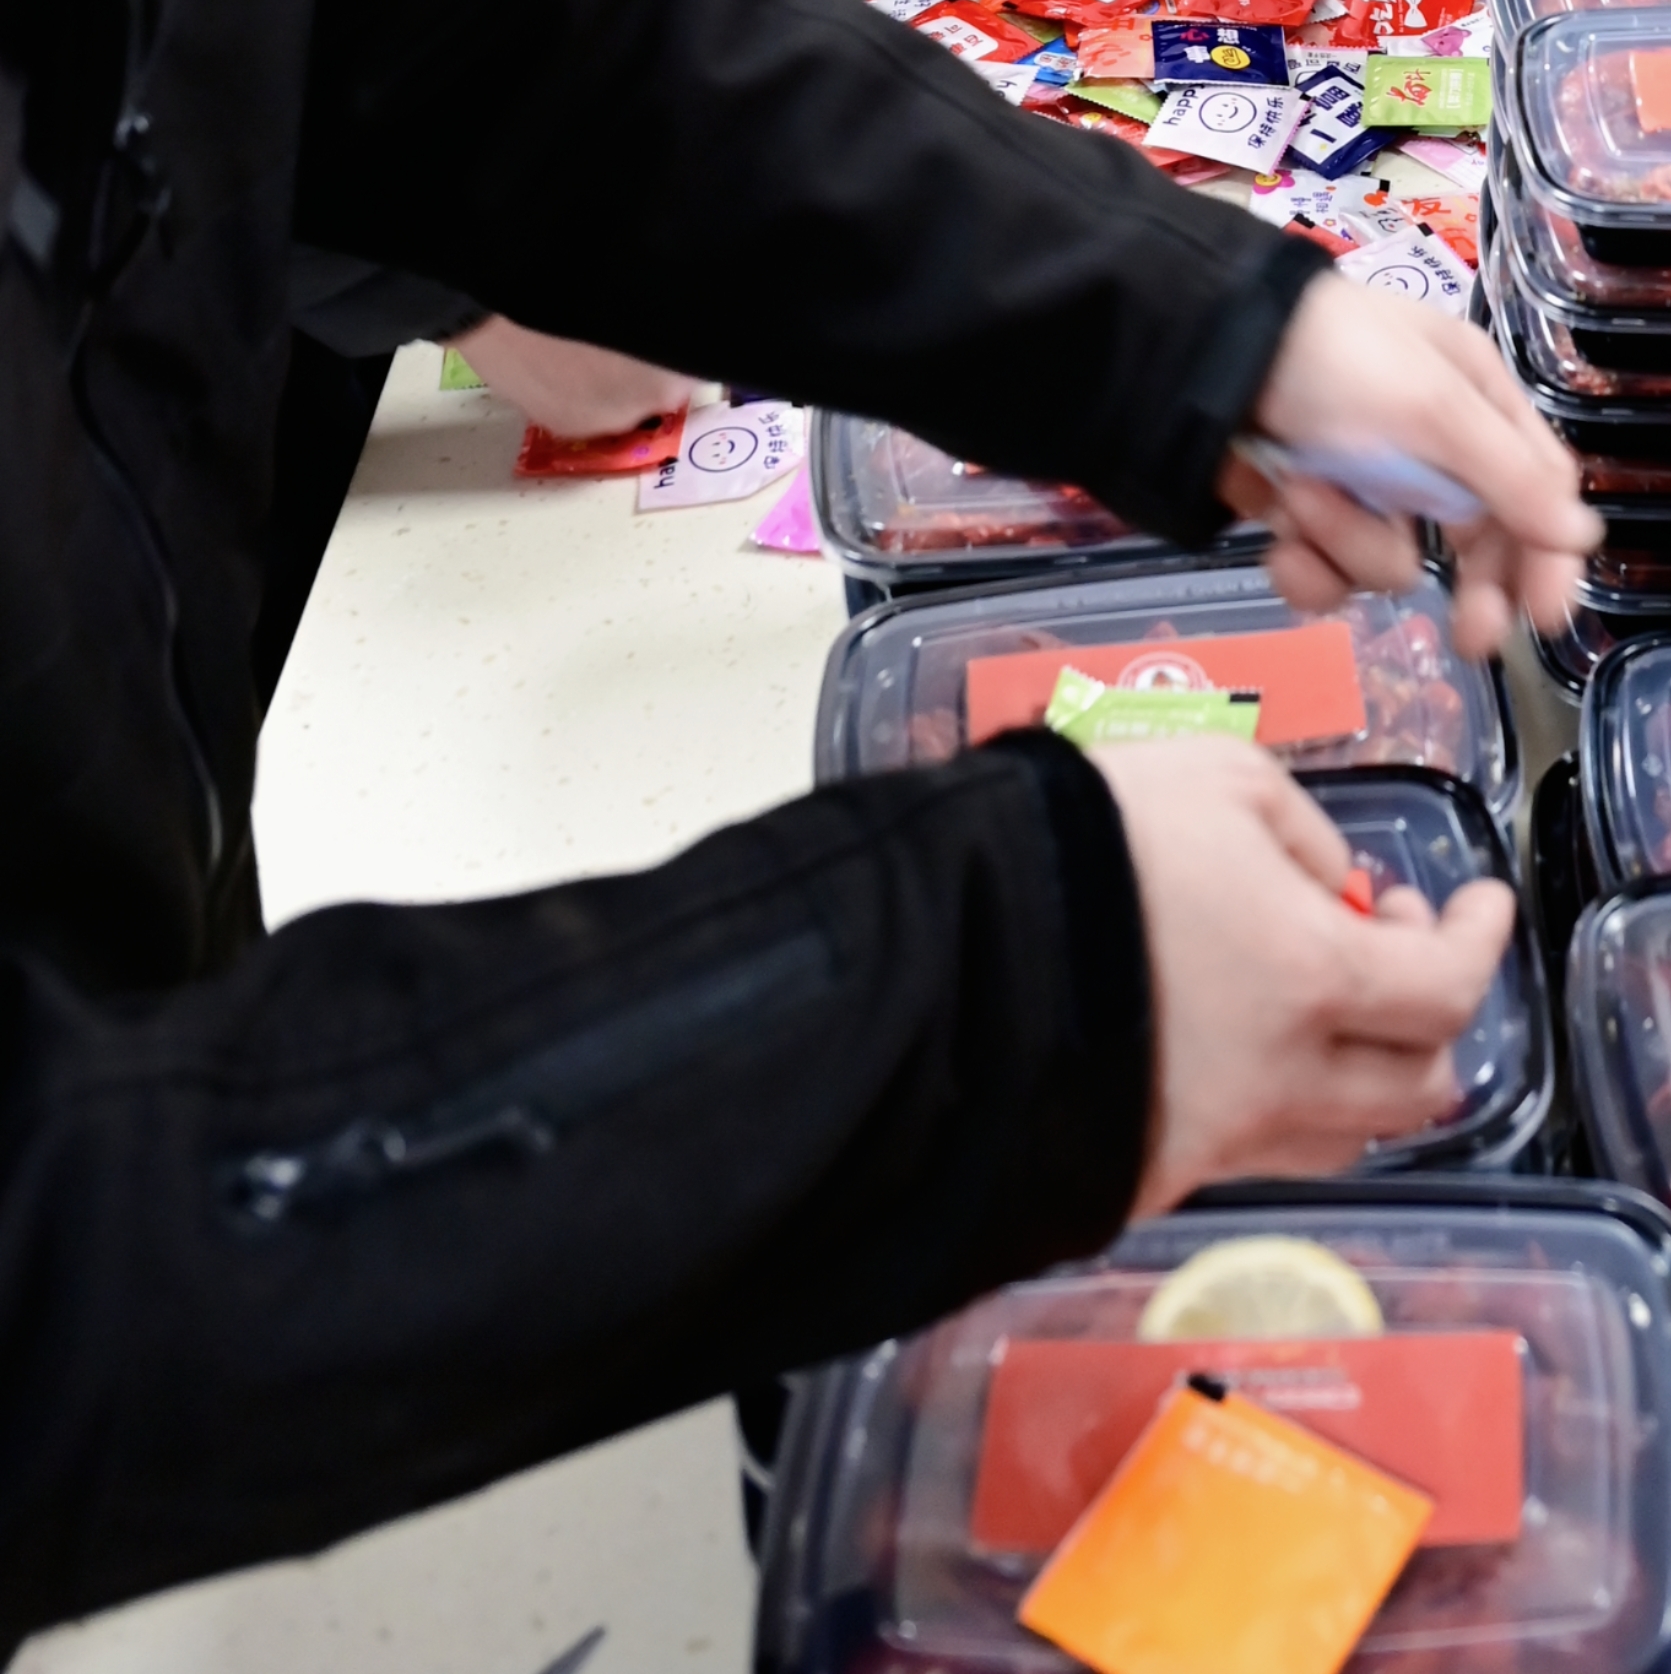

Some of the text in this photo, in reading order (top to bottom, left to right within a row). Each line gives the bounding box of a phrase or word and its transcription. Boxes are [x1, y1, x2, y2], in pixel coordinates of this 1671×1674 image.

[1247, 96, 1284, 149] 保持快乐
[1407, 245, 1461, 297] 保持快乐
